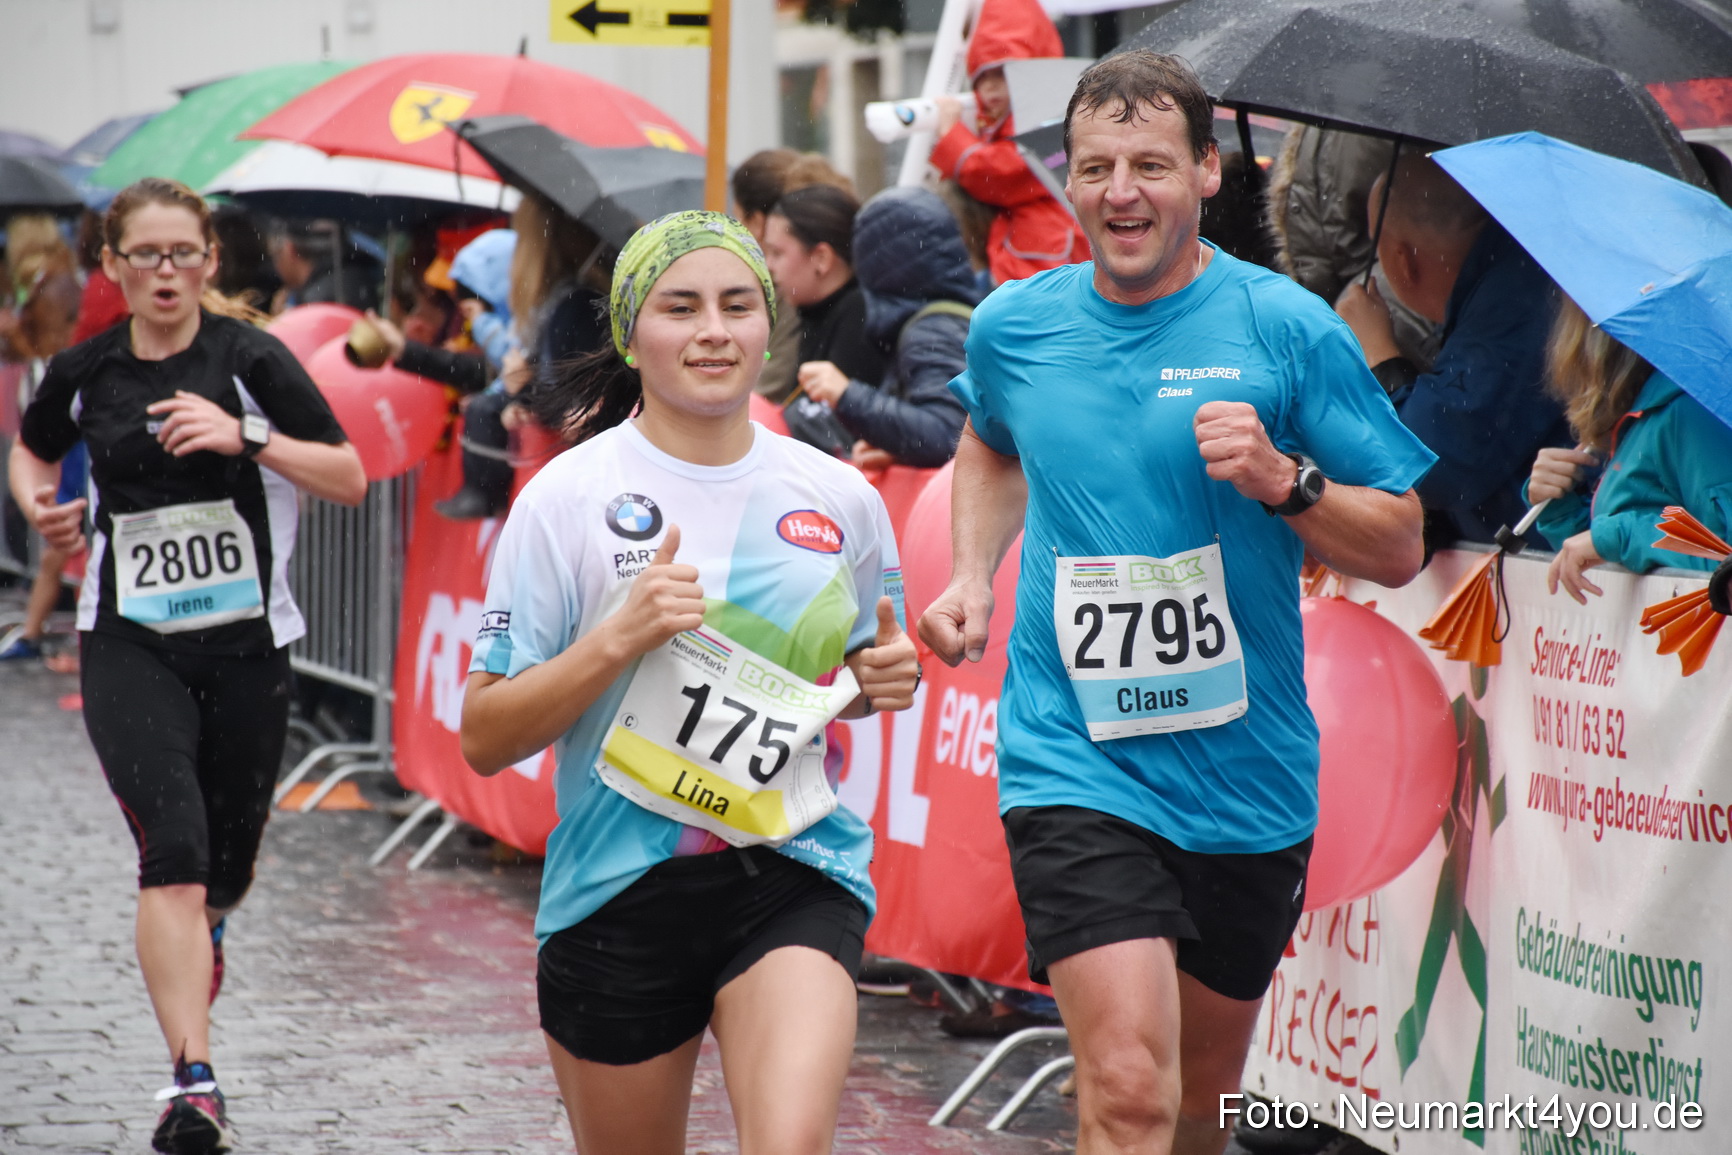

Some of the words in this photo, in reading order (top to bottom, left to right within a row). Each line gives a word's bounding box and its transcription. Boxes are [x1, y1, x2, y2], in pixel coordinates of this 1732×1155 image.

[1157, 387, 1193, 398] Claus
[1174, 367, 1241, 380] PFLEIDERER
[607, 493, 655, 512] BMW
[131, 531, 242, 589] 2806
[1070, 578, 1119, 588] NeuerMarkt
[168, 595, 215, 617] Irene
[1074, 592, 1226, 669] 2795
[670, 637, 728, 676] NeuerMarkt
[1531, 626, 1621, 688] Service-Line:
[737, 659, 832, 712] BOCK
[1116, 687, 1190, 714] Claus
[674, 682, 799, 785] 175
[934, 686, 999, 779] ene
[1582, 704, 1600, 756] 63
[1605, 708, 1627, 760] 52
[671, 769, 731, 817] Lina
[1516, 906, 1703, 1033] Gebäudereinigung
[1516, 1004, 1703, 1114] Hausmeisterdienst
